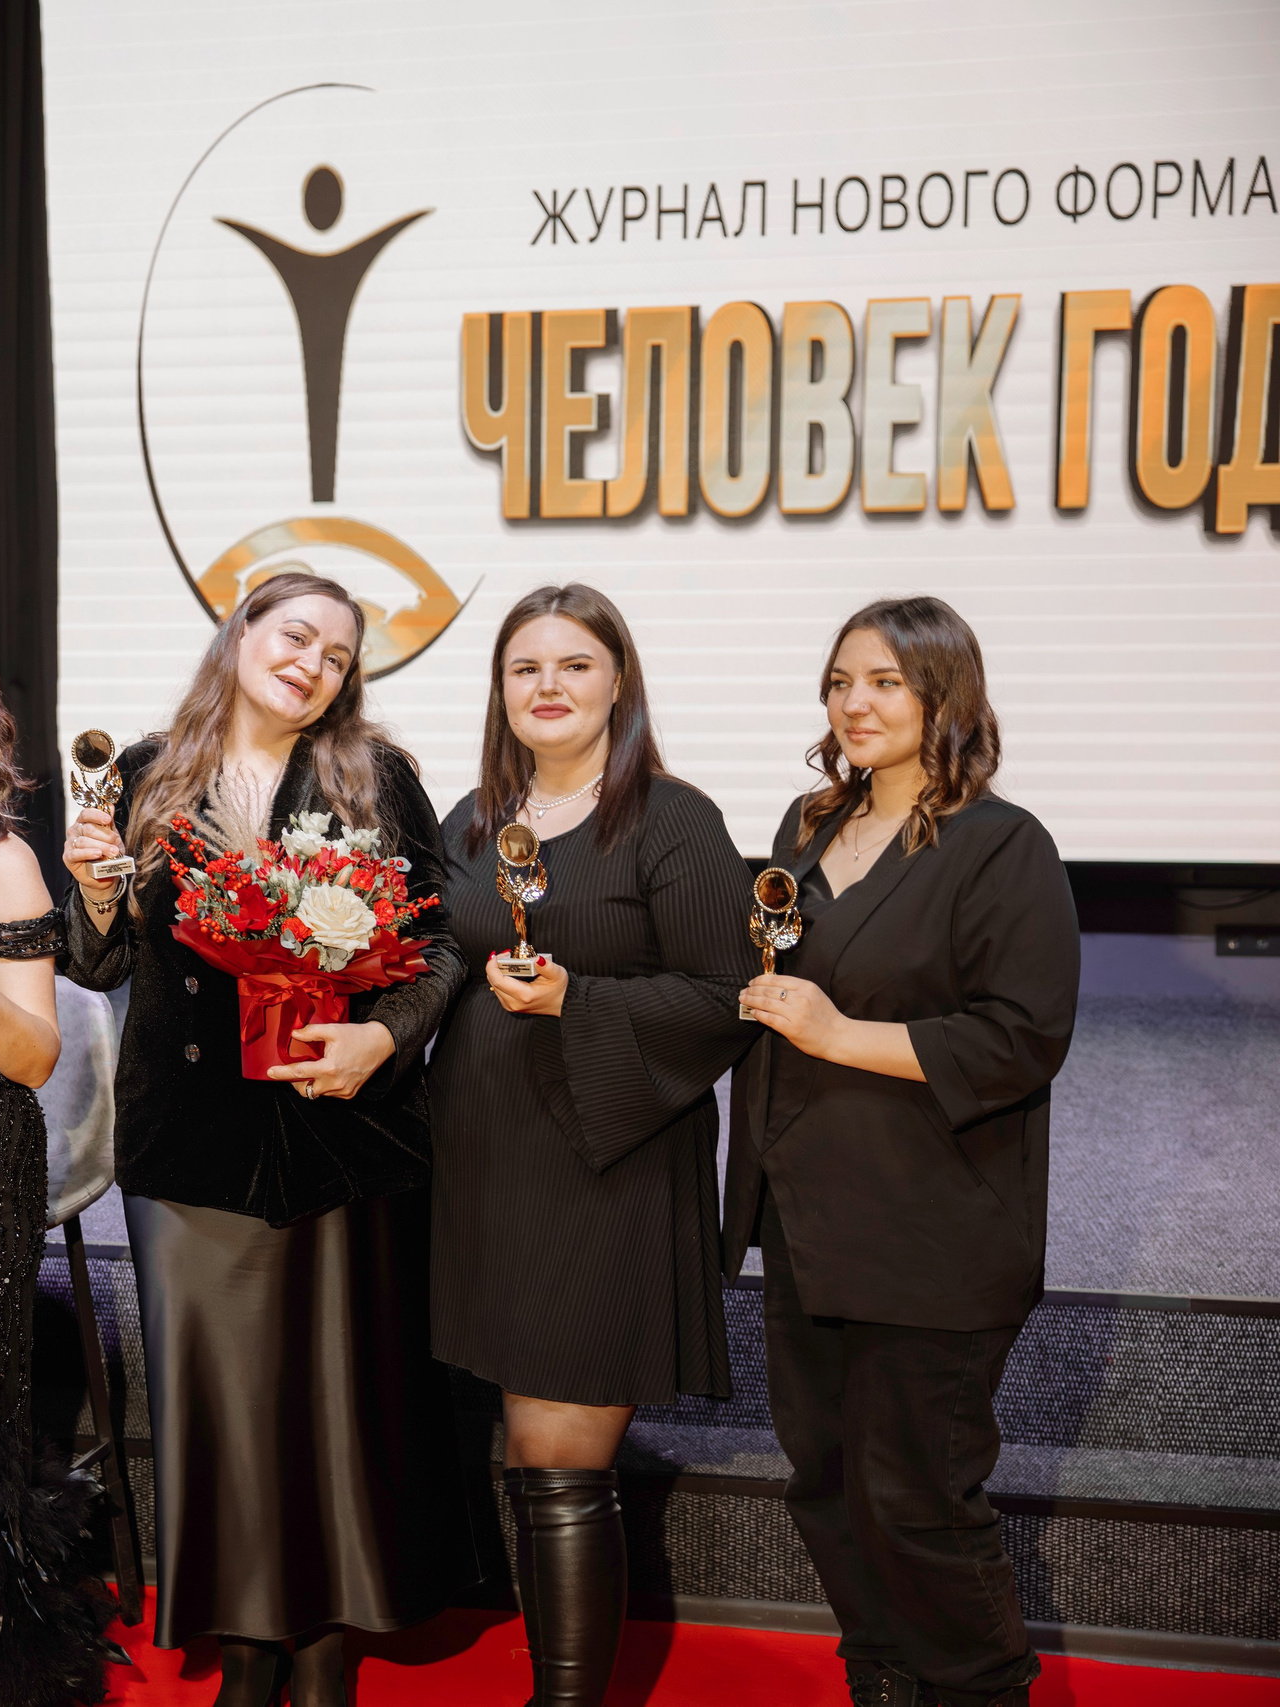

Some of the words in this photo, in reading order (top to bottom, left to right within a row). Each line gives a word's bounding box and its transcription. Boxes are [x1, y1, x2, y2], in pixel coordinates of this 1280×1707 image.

[531, 181, 768, 245] ЖУРНАЛ
[793, 168, 1030, 235] НОВОГО
[1056, 155, 1279, 223] ФОРМА
[462, 293, 1023, 520] ЧЕЛОВЕК
